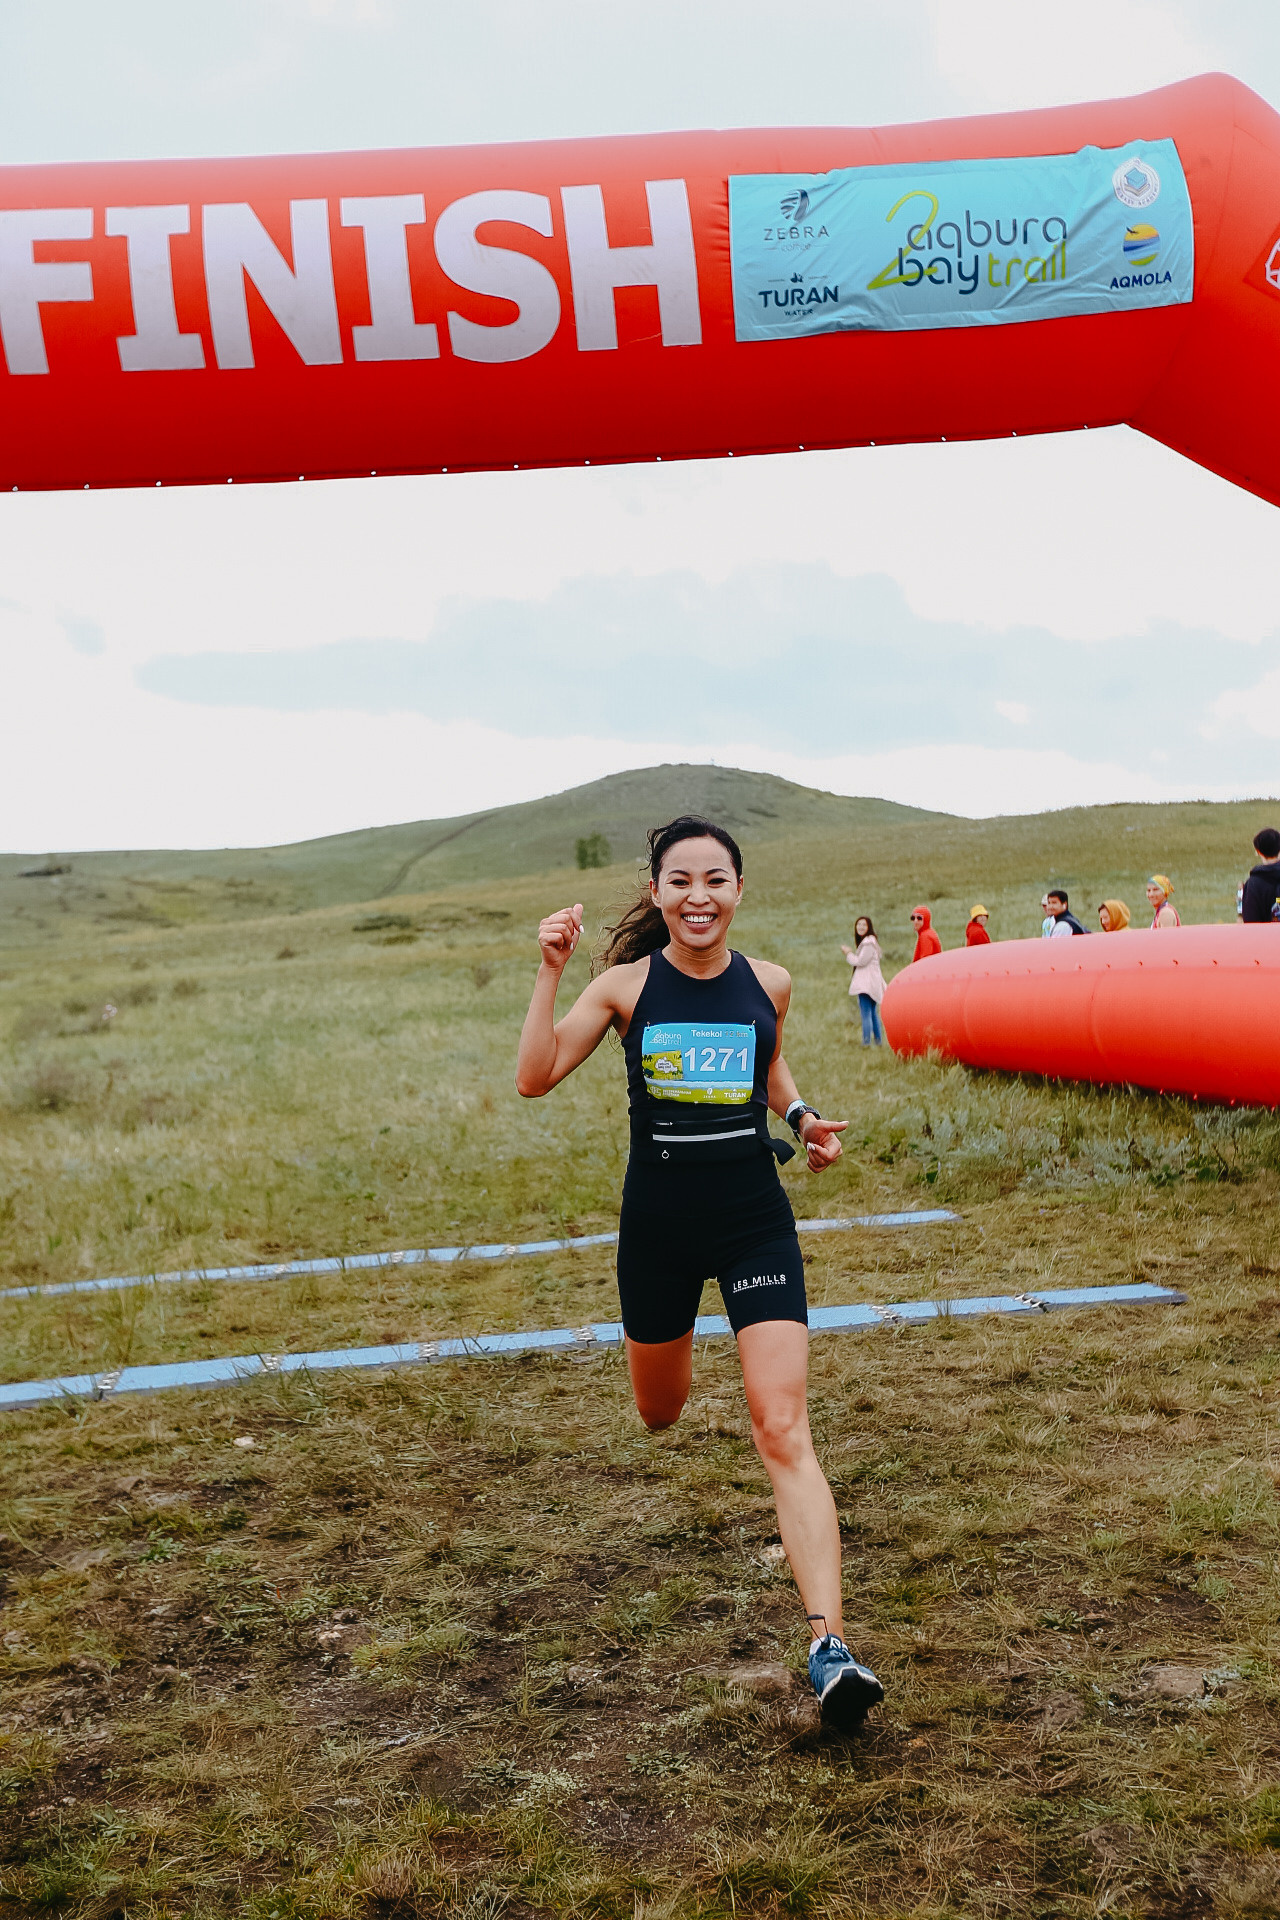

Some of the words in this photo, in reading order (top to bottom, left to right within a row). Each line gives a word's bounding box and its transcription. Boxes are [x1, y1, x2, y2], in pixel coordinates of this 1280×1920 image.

[763, 225, 830, 241] ZEBRA
[0, 178, 702, 375] FINISH
[898, 247, 979, 295] bay
[988, 241, 1067, 287] trail
[1110, 270, 1172, 289] AQMOLA
[758, 285, 839, 308] TURAN
[736, 1030, 748, 1038] km
[684, 1047, 748, 1072] 1271
[733, 1279, 748, 1290] LES
[752, 1274, 786, 1284] MILLS
